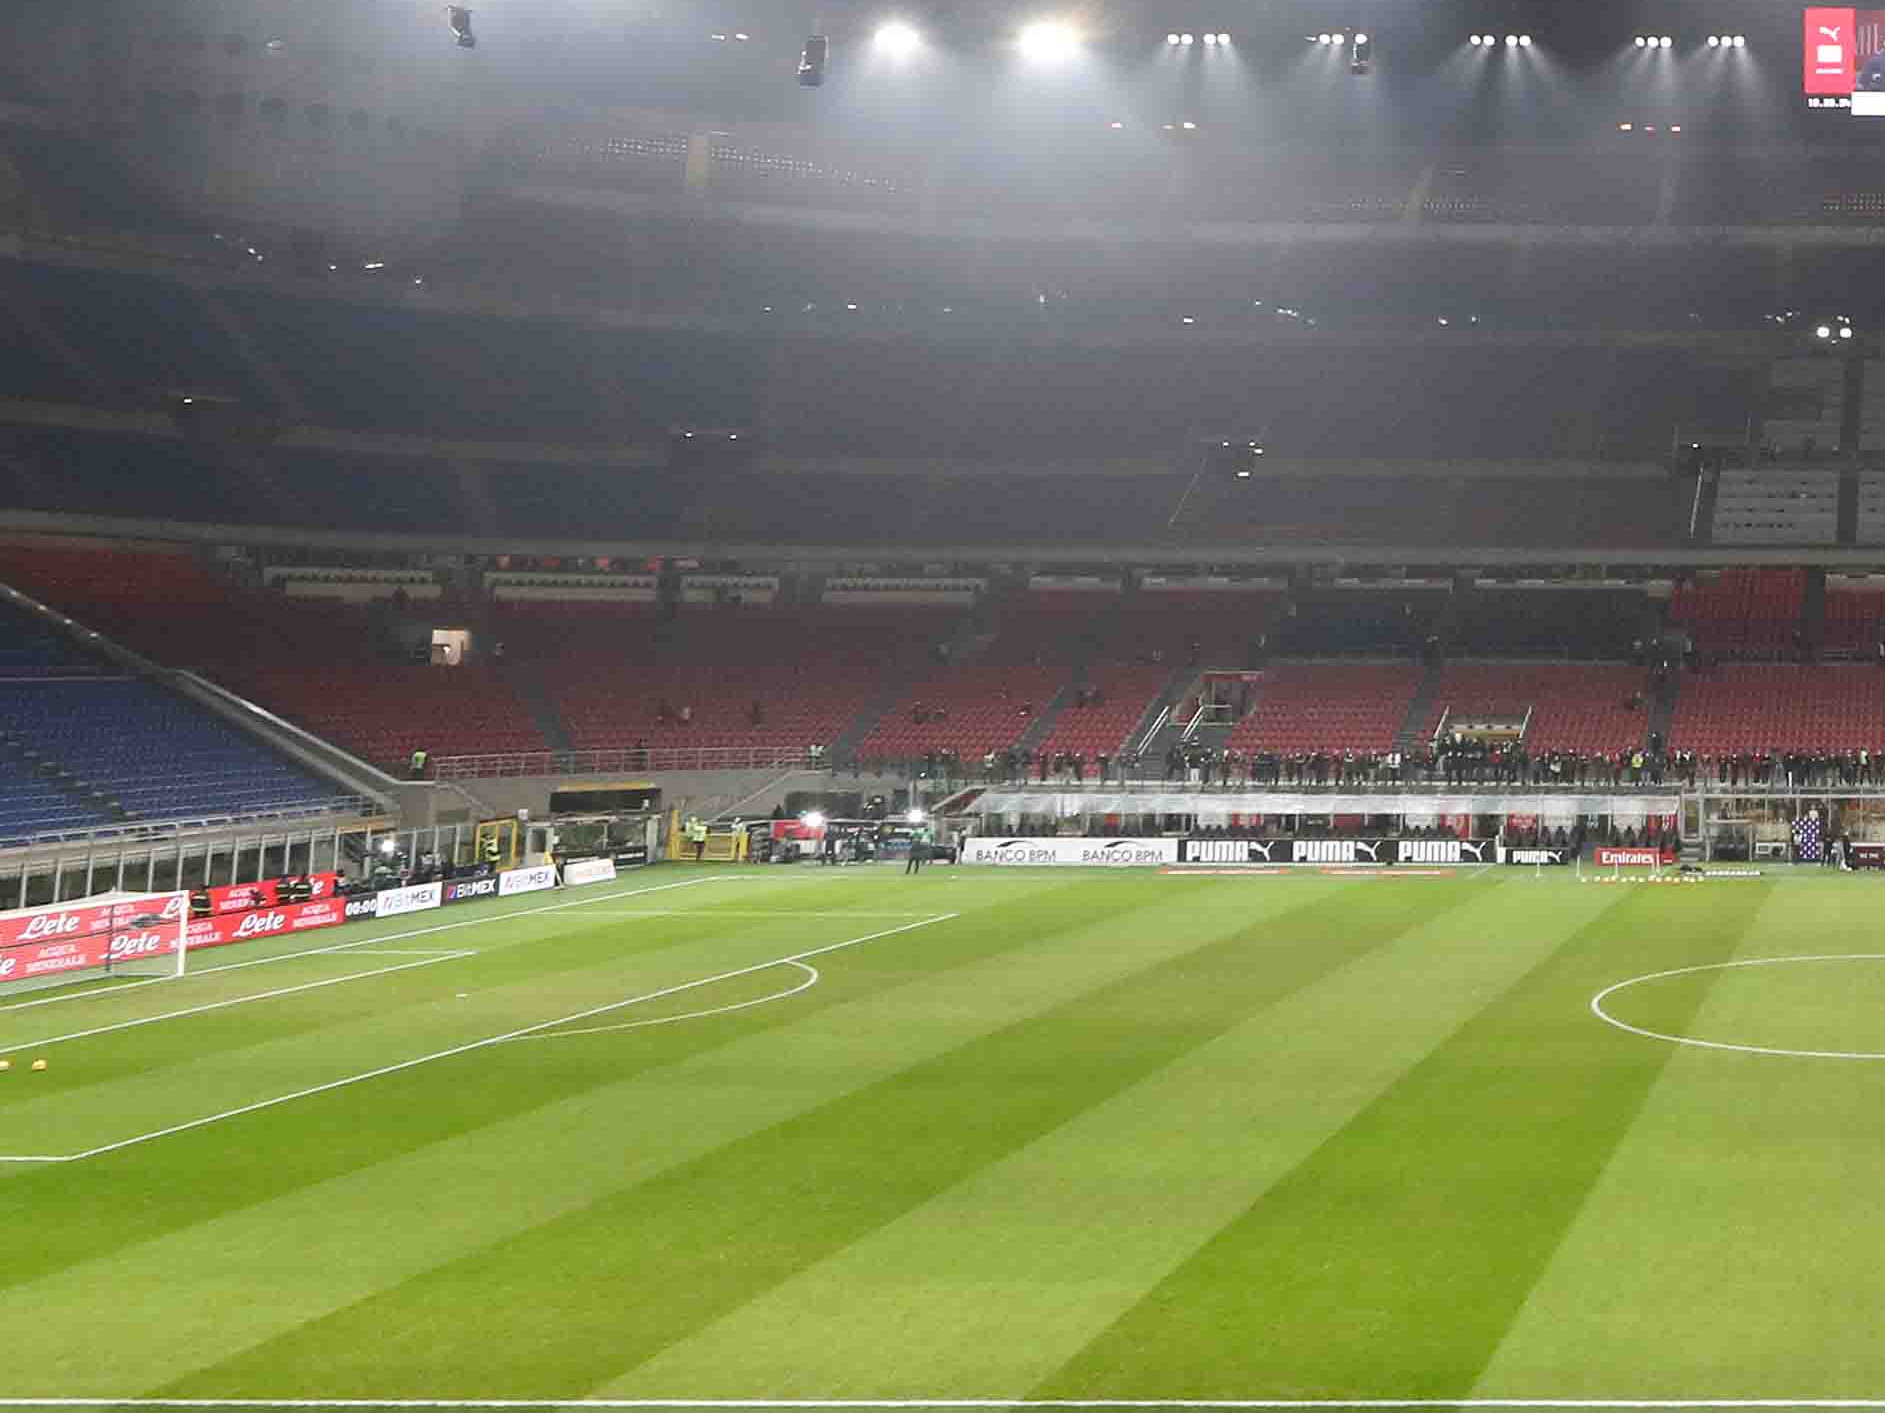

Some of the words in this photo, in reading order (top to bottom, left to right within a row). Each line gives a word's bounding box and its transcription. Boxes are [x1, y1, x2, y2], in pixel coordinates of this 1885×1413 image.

[976, 849, 1026, 862] BANCO
[1029, 849, 1057, 862] BPM
[1082, 849, 1133, 862] BANCO
[1135, 849, 1163, 862] BPM
[1186, 841, 1249, 862] PUMA
[1292, 841, 1355, 862] PUMA
[1398, 841, 1461, 862] PUMA
[1513, 850, 1548, 864] PUMA
[1601, 851, 1655, 865] Emirates
[232, 910, 286, 937] Lete
